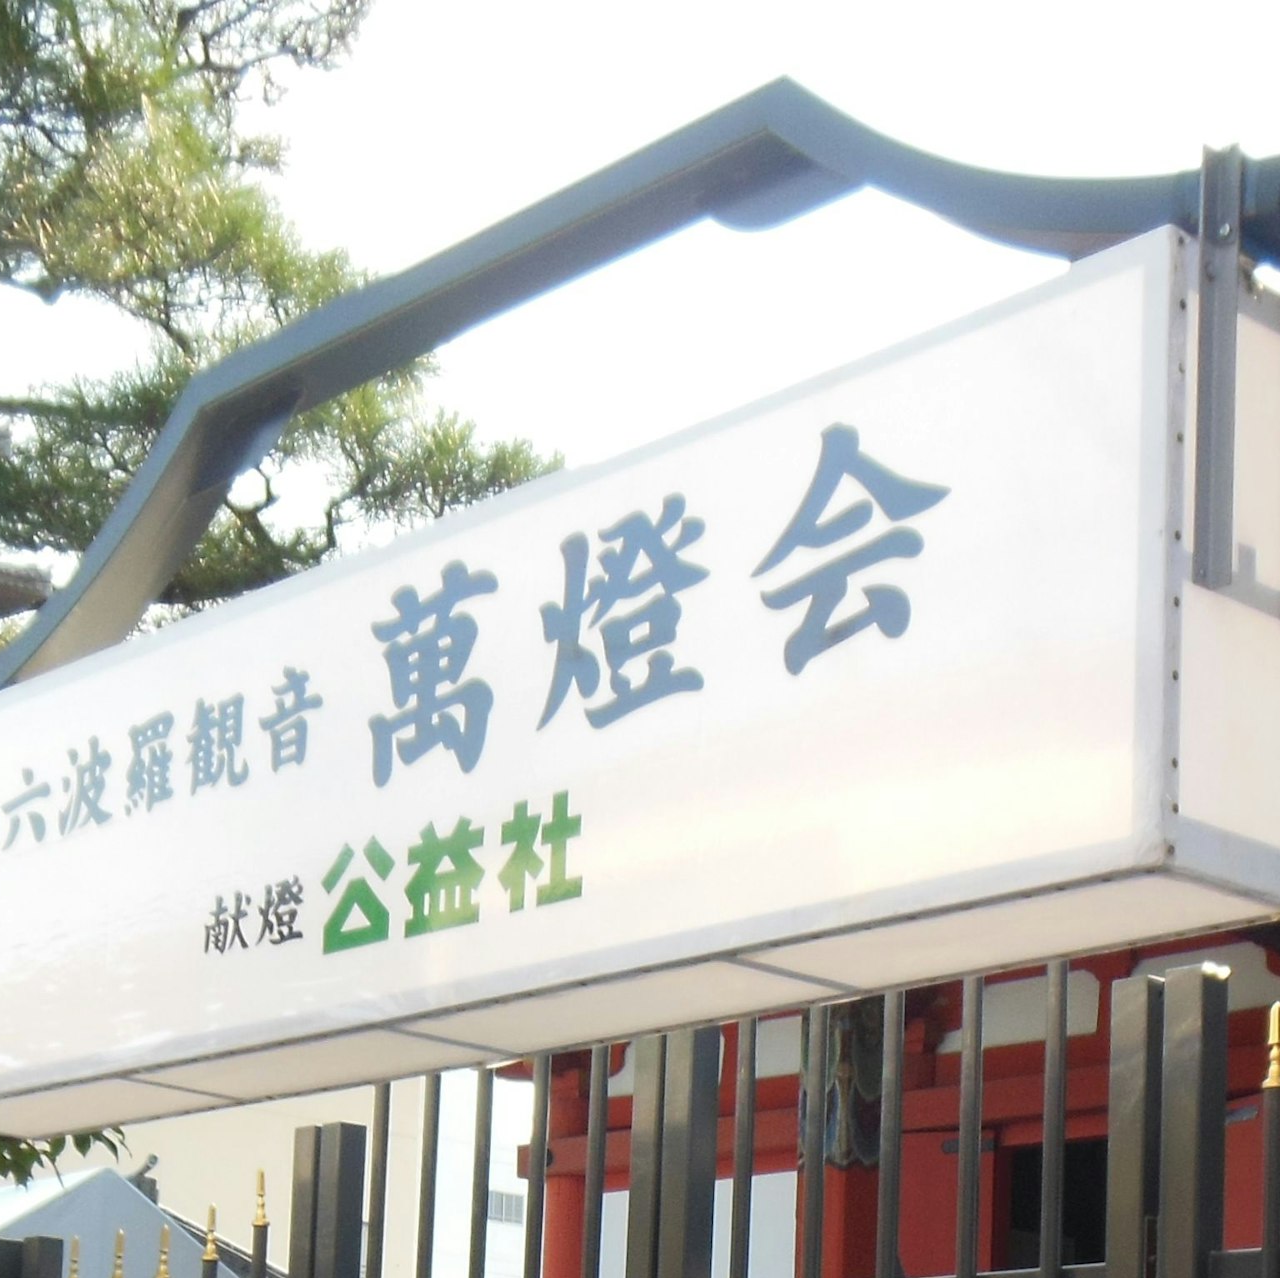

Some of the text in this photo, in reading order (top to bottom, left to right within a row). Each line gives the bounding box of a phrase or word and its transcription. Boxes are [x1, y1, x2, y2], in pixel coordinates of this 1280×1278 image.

[369, 422, 951, 788] 萬燈会
[1, 665, 324, 852] 六波羅観音
[203, 874, 304, 955] 献燈
[321, 790, 583, 955] 公益社
